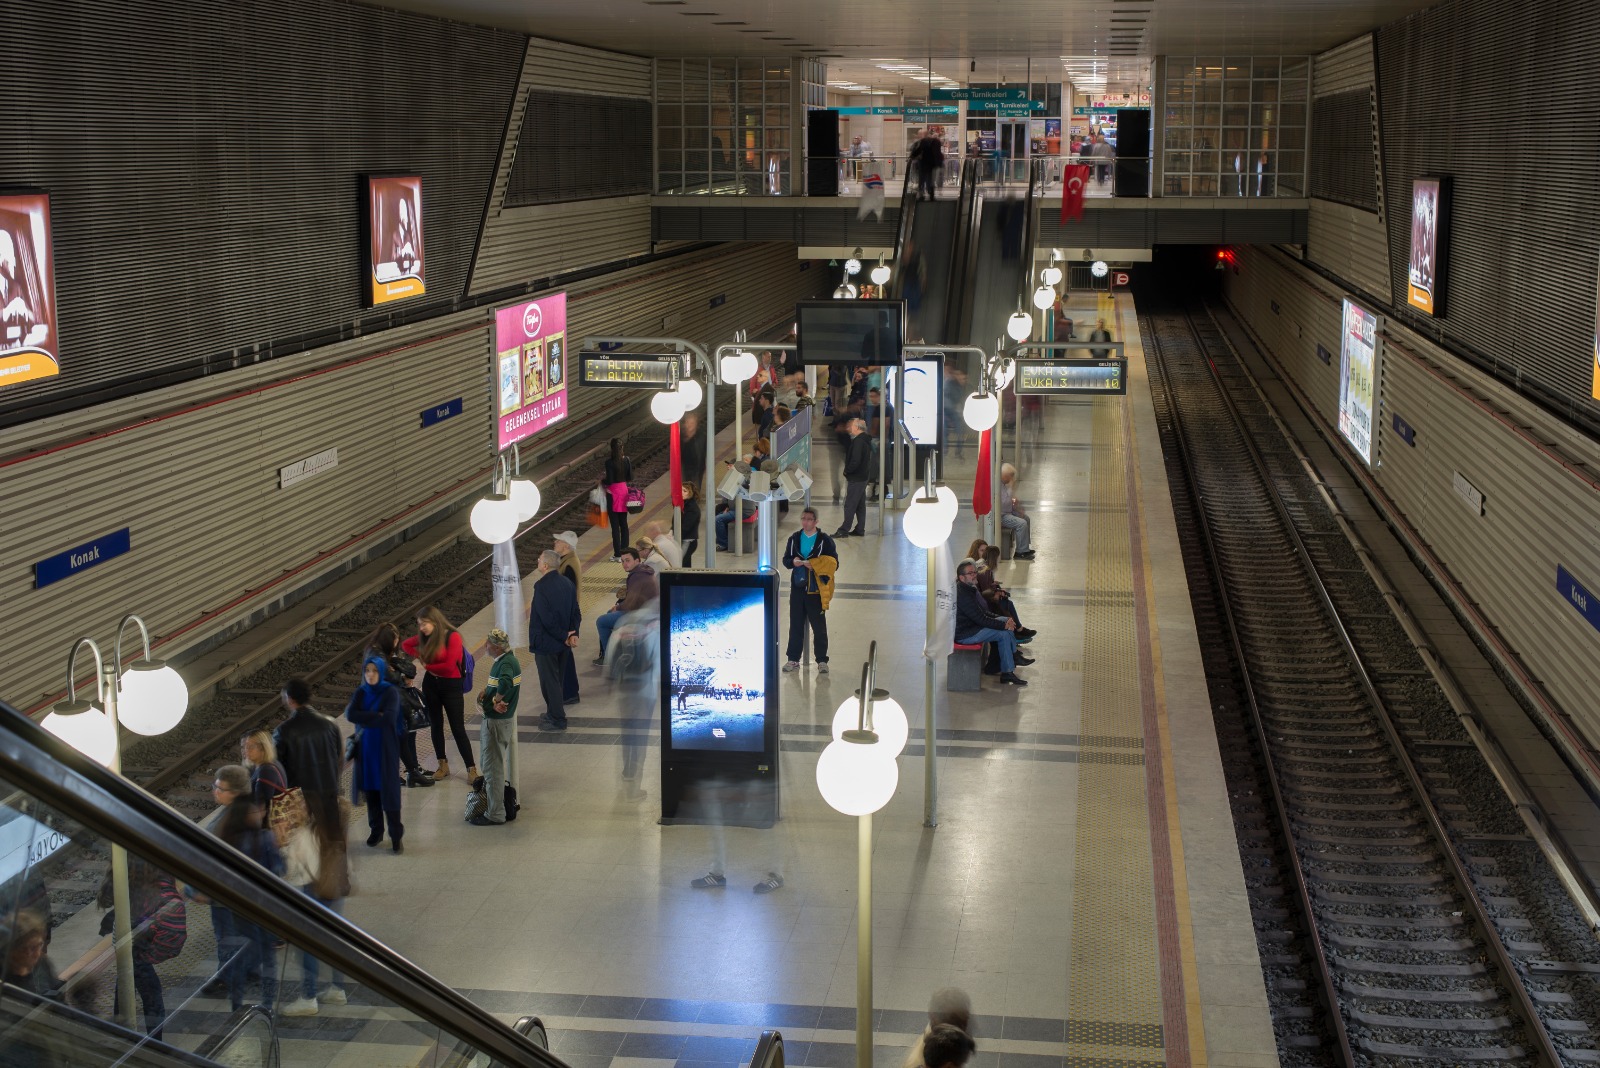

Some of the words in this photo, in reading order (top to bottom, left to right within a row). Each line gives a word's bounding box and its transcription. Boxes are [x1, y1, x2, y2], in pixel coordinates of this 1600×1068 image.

[951, 91, 968, 99] Çıkış
[587, 360, 599, 369] F.
[607, 360, 643, 370] ALTAY
[587, 371, 599, 380] F.
[607, 371, 643, 381] ALTAY
[1023, 367, 1053, 376] EVKA
[1060, 367, 1068, 376] 3
[1111, 367, 1120, 376] 5
[1023, 379, 1053, 388] EVKA
[1060, 379, 1068, 388] 3
[1105, 379, 1119, 388] 10
[436, 405, 450, 418] Konak
[505, 406, 541, 433] GELENEKSEL
[541, 396, 562, 415] TATLAR
[70, 545, 100, 569] Konak
[1571, 584, 1587, 612] Konak
